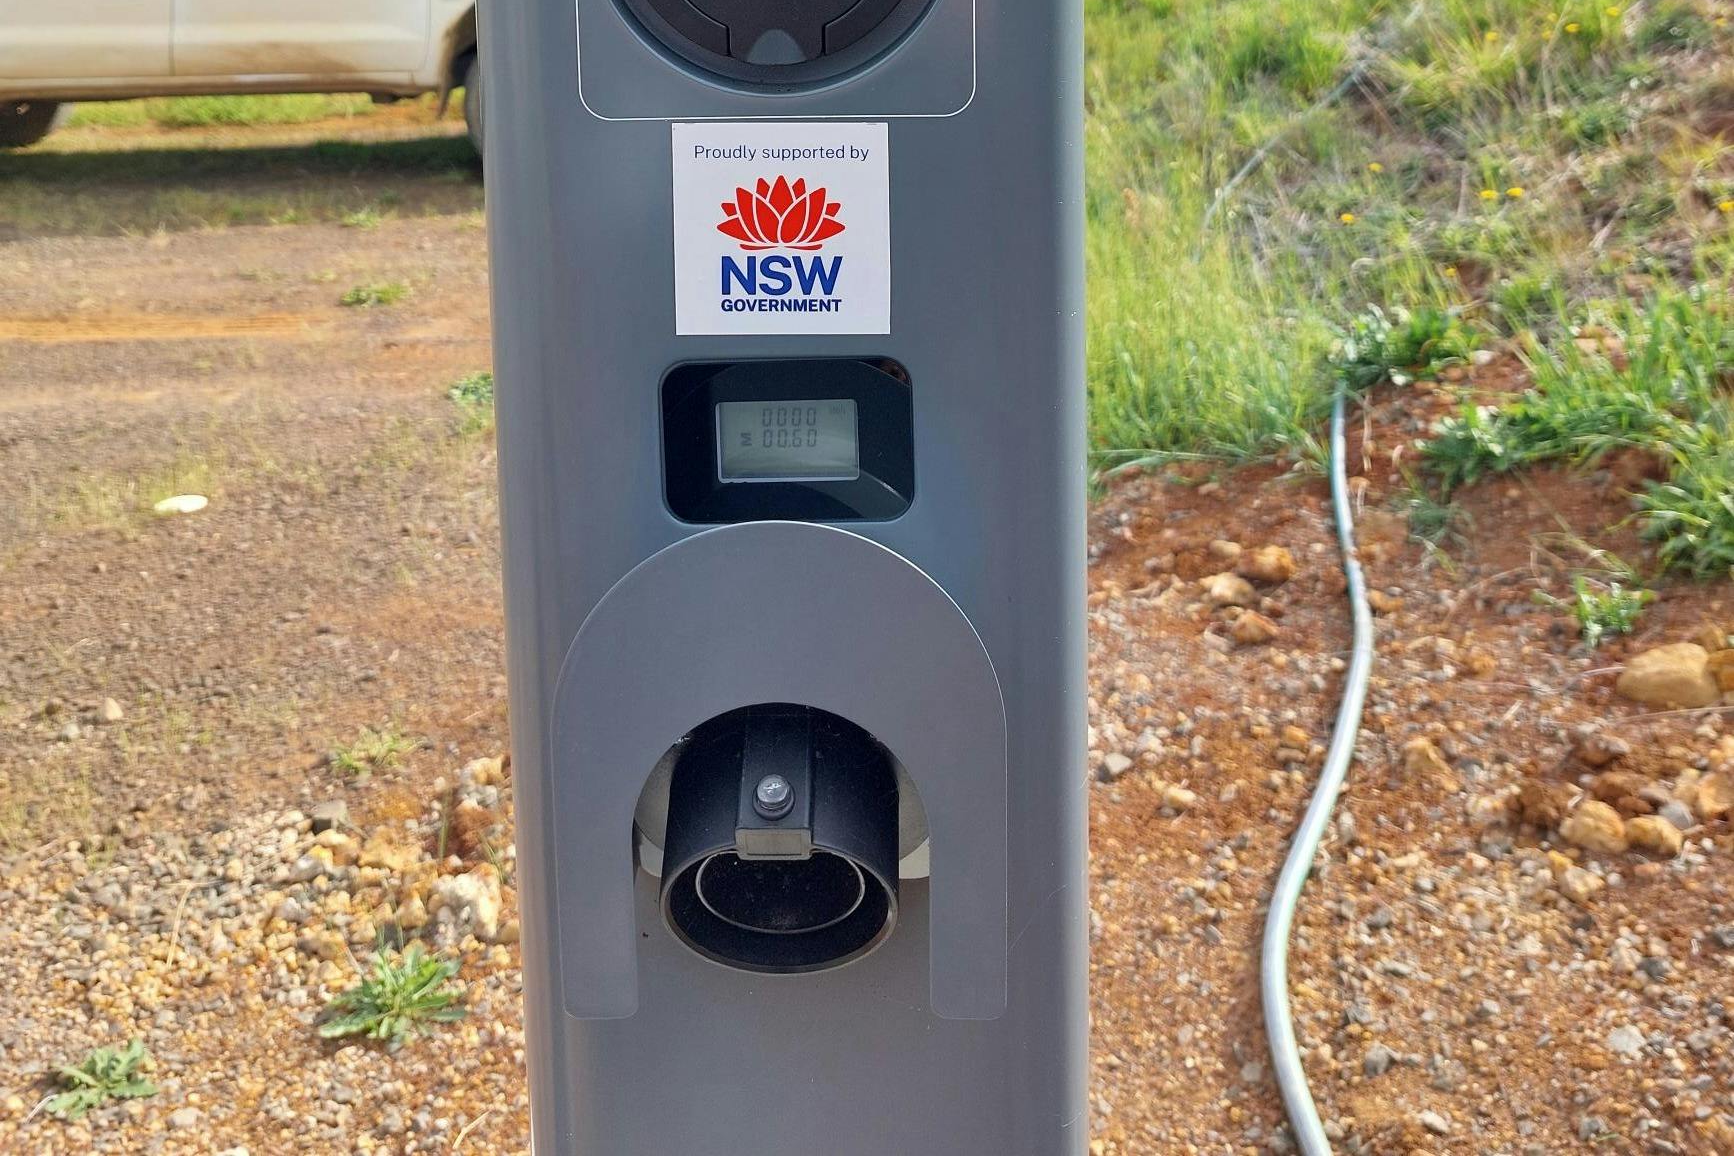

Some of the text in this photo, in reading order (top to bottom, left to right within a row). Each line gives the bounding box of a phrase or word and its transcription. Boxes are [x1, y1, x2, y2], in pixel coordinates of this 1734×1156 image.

[694, 145, 869, 162] Proudly supported by
[721, 255, 843, 296] NSW
[721, 299, 842, 312] GOVERNMENT
[762, 407, 817, 427] 0000
